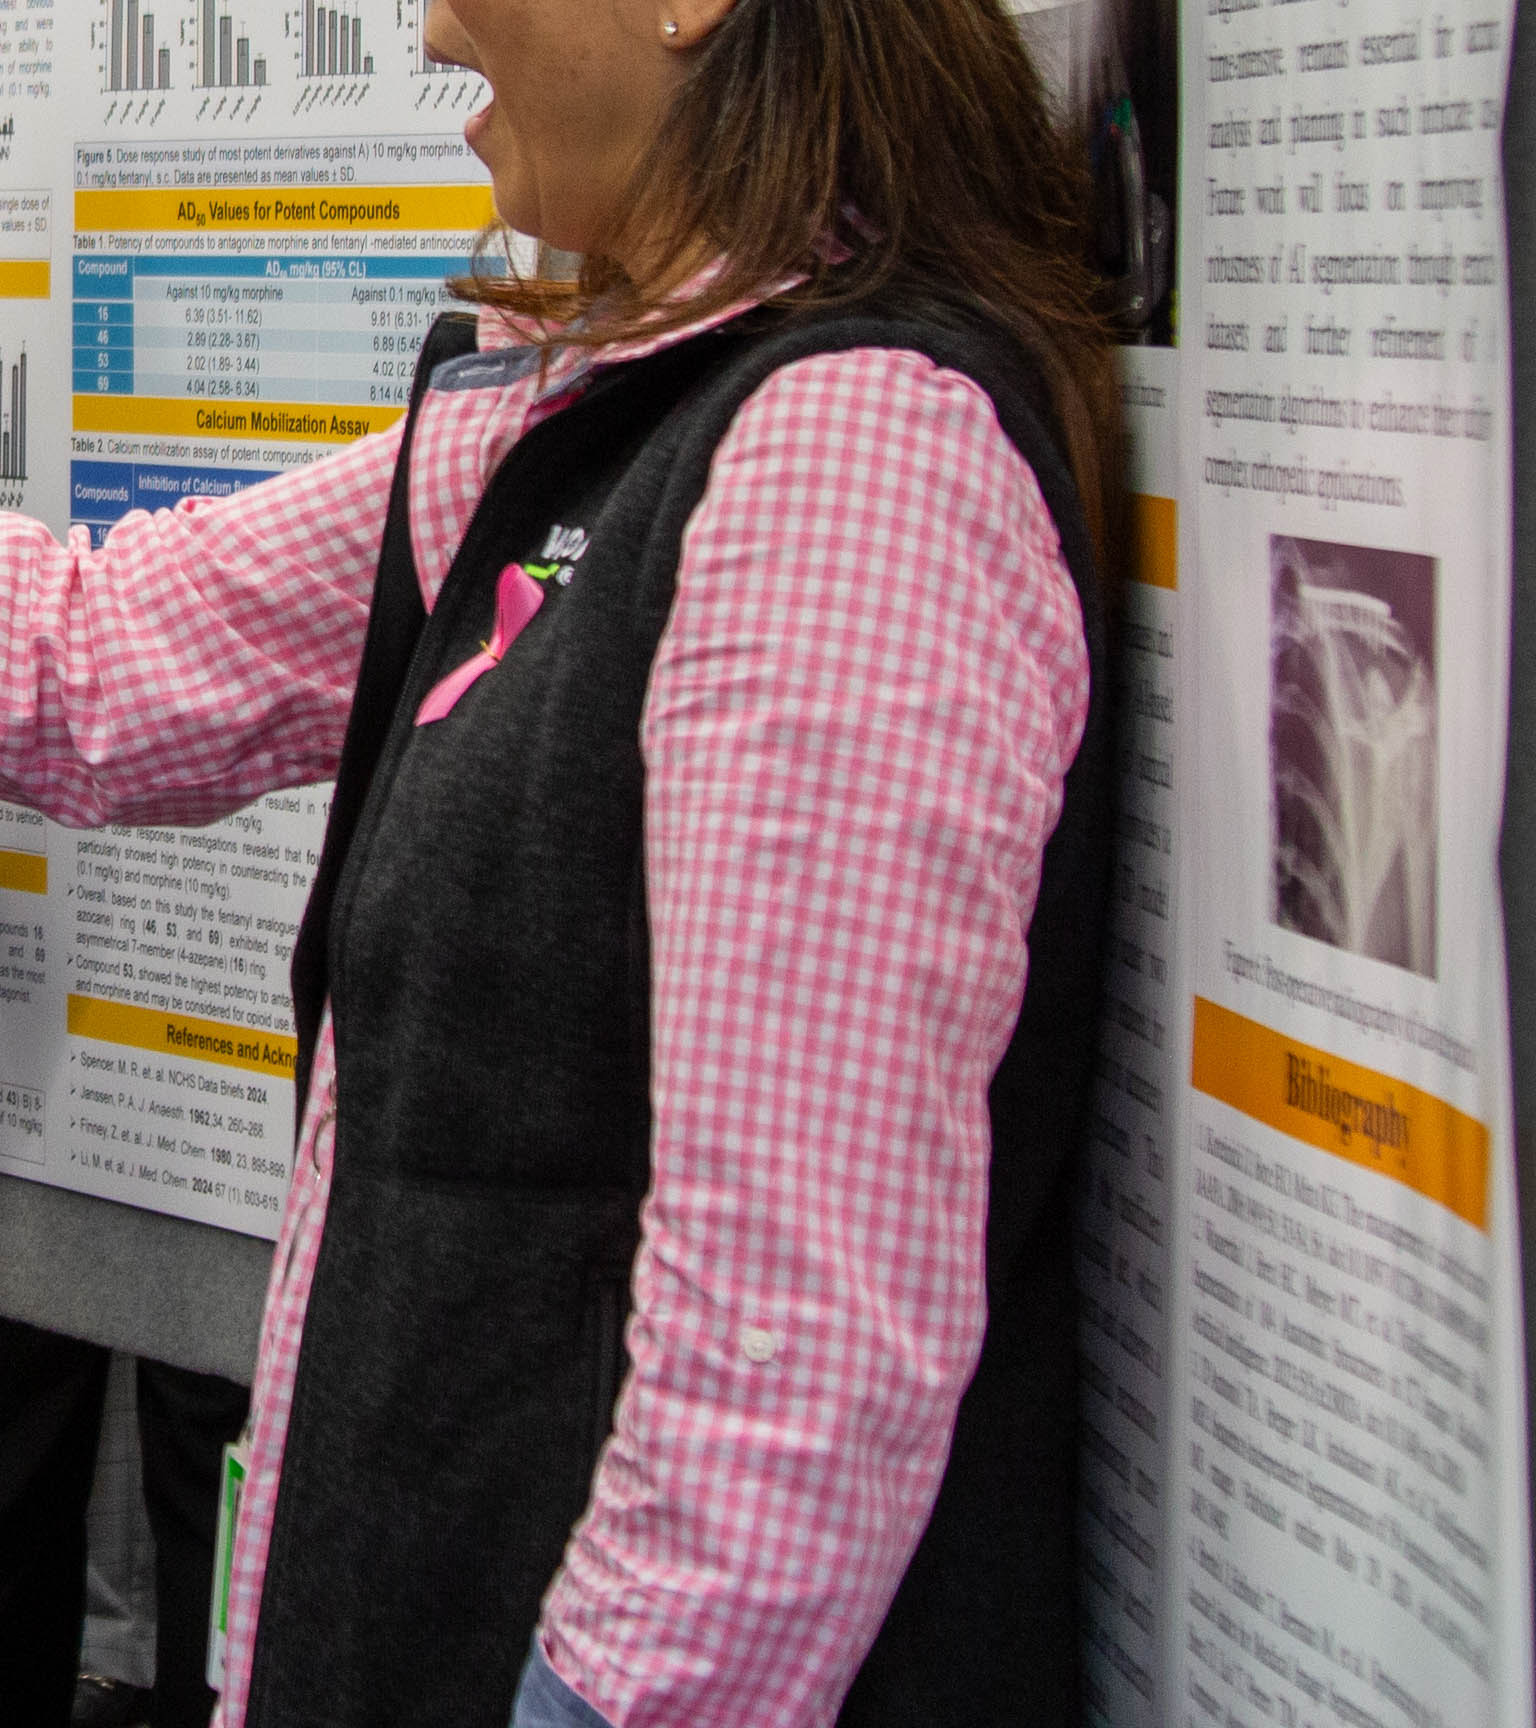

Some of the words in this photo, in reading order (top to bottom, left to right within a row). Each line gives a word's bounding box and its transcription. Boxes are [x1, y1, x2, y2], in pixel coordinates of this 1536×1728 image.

[76, 148, 104, 167] Figure
[116, 147, 138, 163] Dose
[140, 149, 180, 166] response
[182, 146, 206, 165] study
[207, 145, 217, 161] of
[218, 145, 241, 161] most
[243, 145, 271, 164] potent
[273, 144, 320, 160] derivatives
[322, 143, 356, 162] against
[372, 141, 384, 158] 10
[386, 141, 417, 162] mg/kg
[419, 141, 463, 160] morphine
[208, 200, 249, 220] Values
[253, 200, 271, 220] for
[274, 200, 315, 220] Potent
[319, 199, 400, 224] Compounds
[77, 258, 127, 278] Compound
[165, 282, 198, 302] Against
[200, 282, 211, 300] 10
[212, 284, 239, 303] mg/kg
[241, 284, 283, 302] morphine
[351, 285, 387, 305] Against
[388, 286, 403, 302] 0.1
[406, 287, 435, 306] mg/kg
[196, 408, 247, 430] Calcium
[250, 410, 326, 434] Mobilization
[166, 1023, 234, 1055] References
[236, 1041, 259, 1061] and
[197, 1074, 218, 1094] Data
[1286, 1052, 1410, 1168] Bibliography
